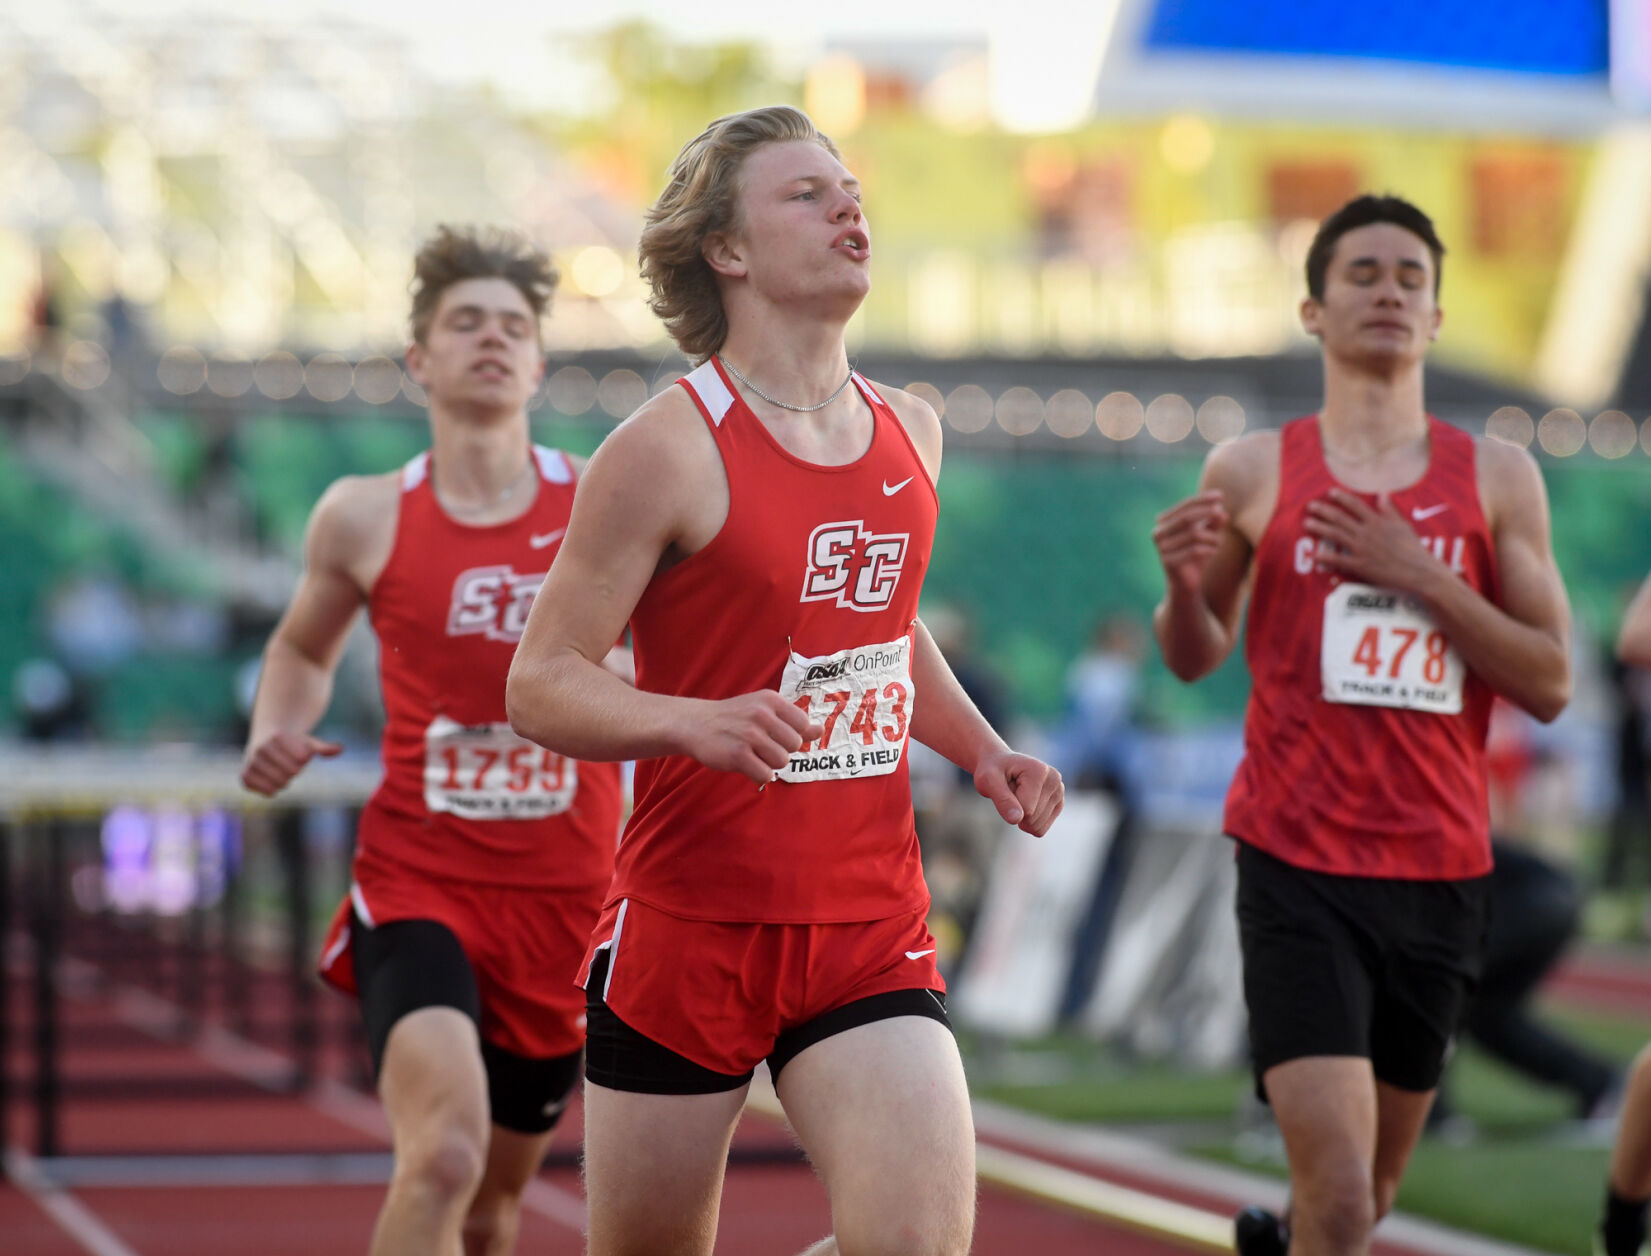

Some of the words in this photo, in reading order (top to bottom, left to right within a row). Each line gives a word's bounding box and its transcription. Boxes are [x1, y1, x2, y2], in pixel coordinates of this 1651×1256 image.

[800, 520, 910, 612] SC
[854, 649, 902, 672] OnPoint
[1352, 626, 1446, 686] 478
[794, 681, 907, 754] 1743
[440, 746, 565, 793] 1759
[789, 754, 841, 773] TRACK
[846, 754, 856, 768] &
[861, 748, 900, 767] FIELD
